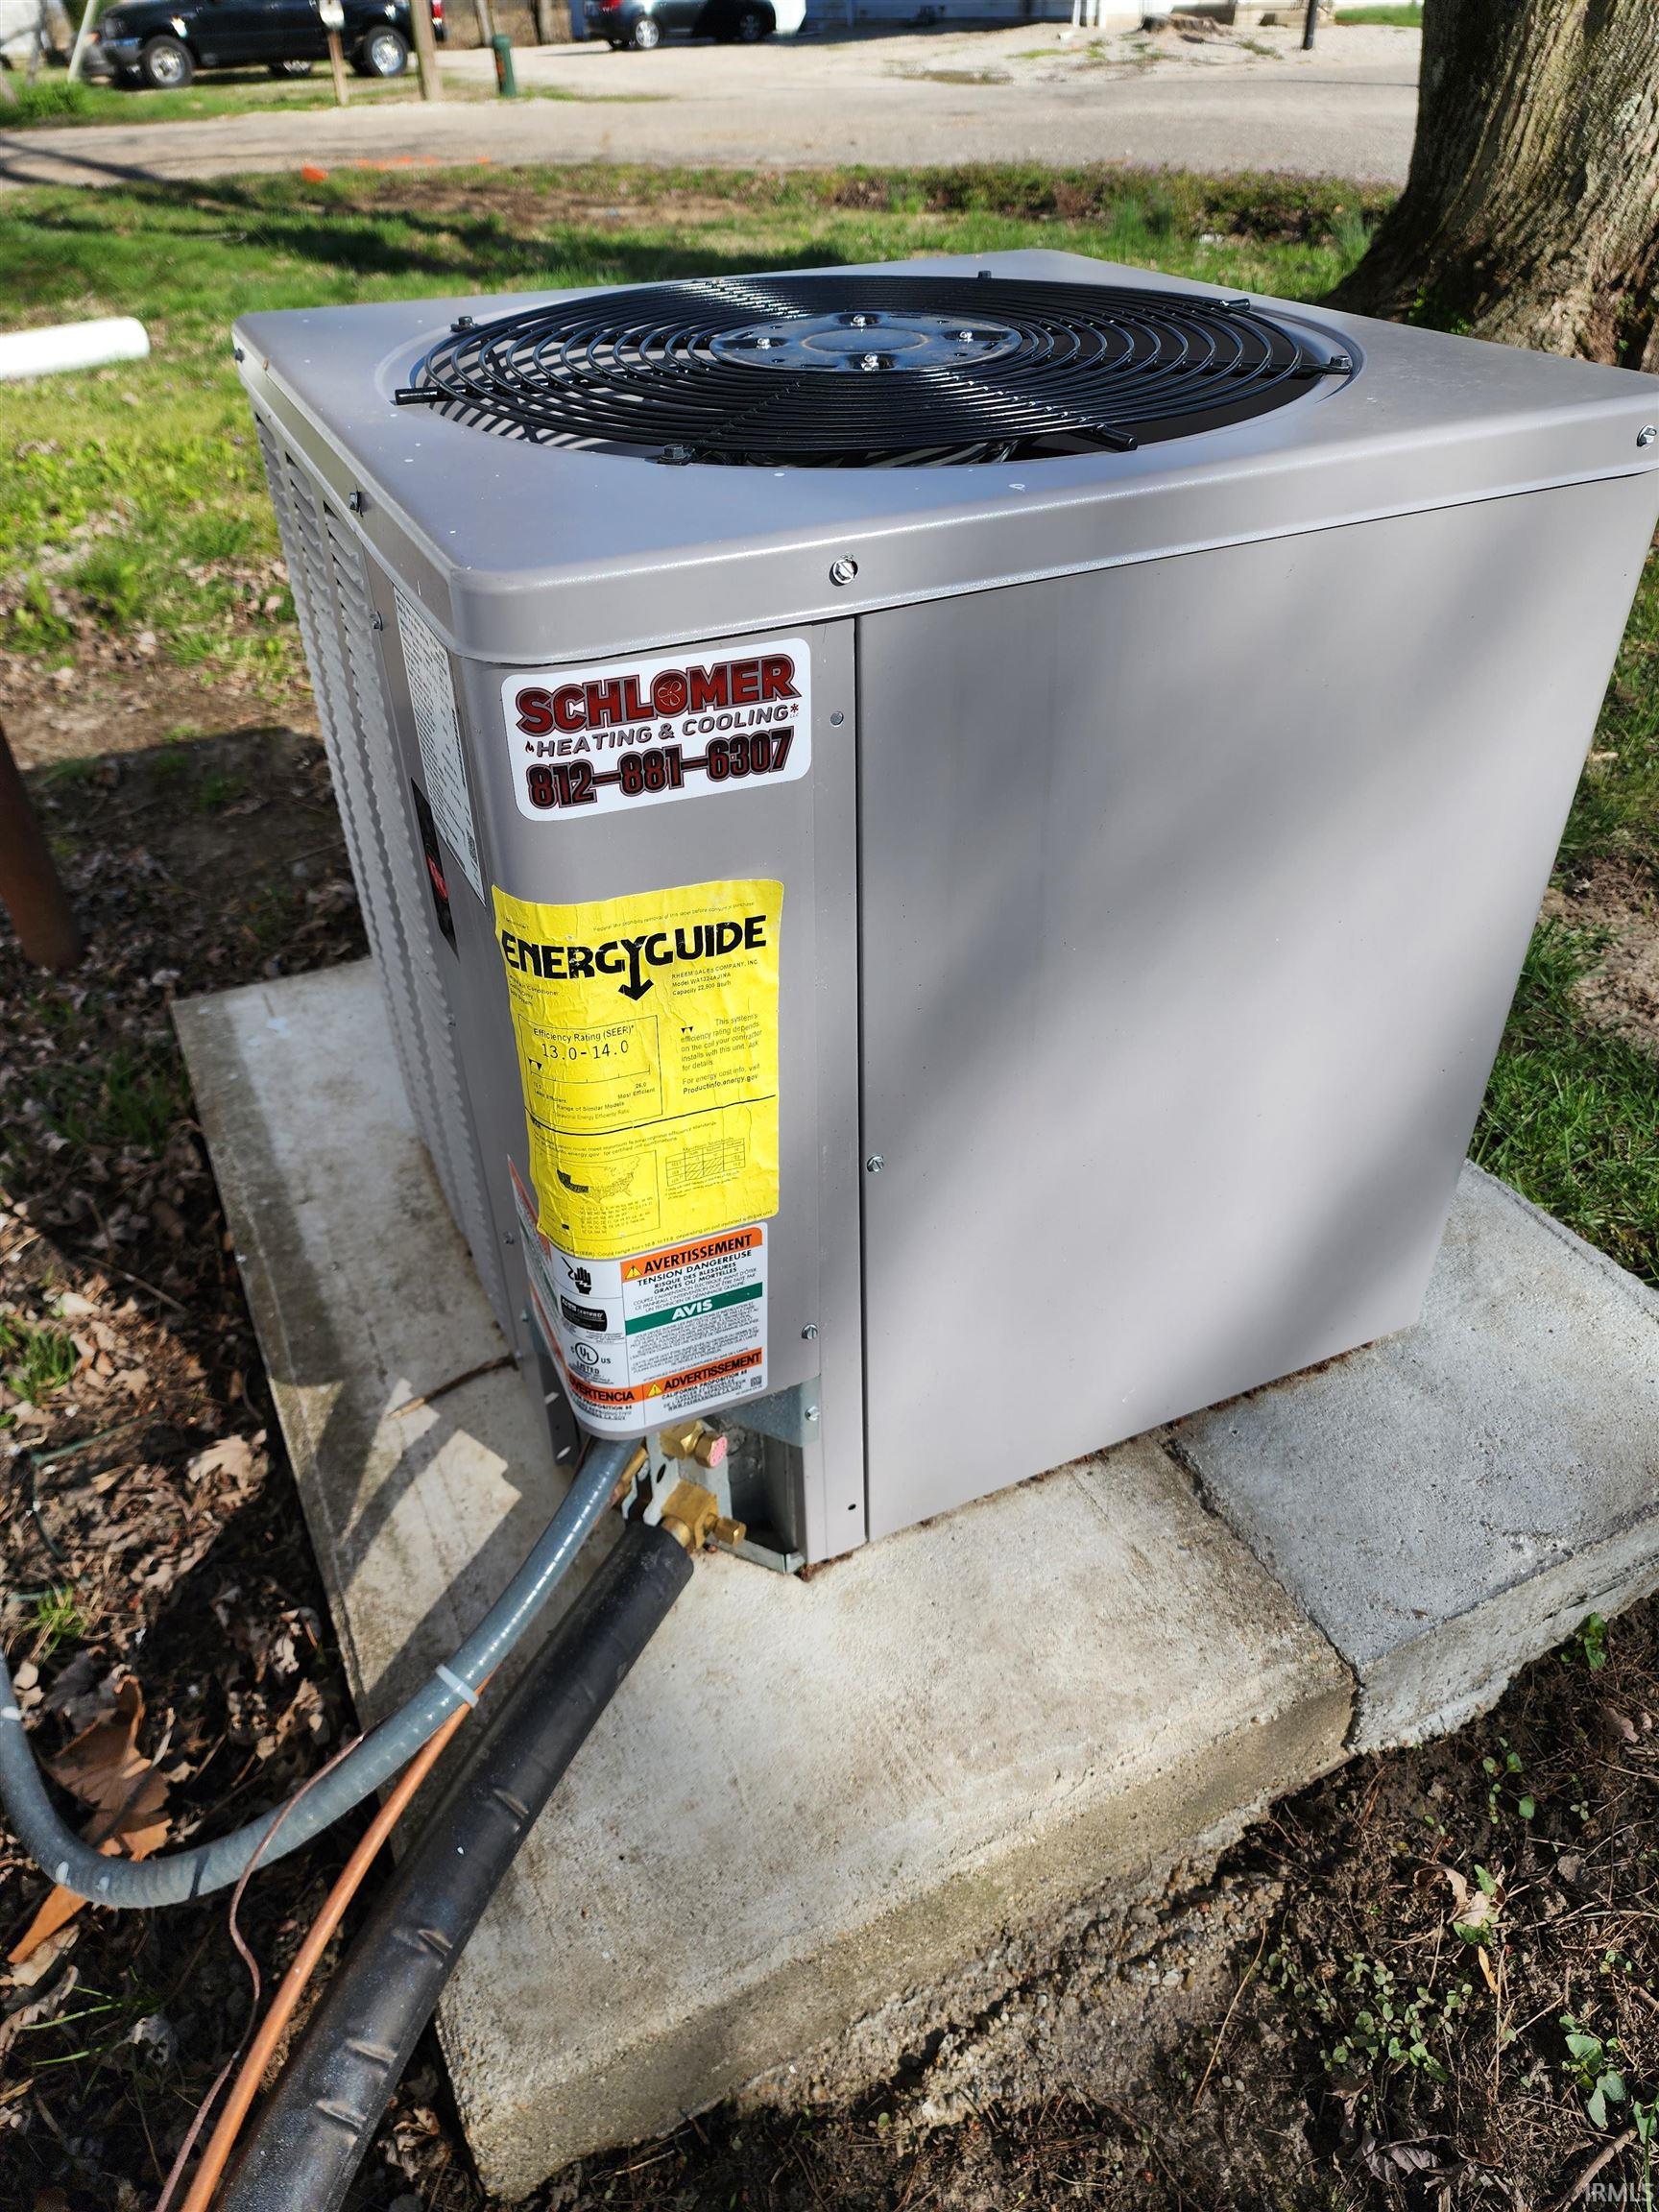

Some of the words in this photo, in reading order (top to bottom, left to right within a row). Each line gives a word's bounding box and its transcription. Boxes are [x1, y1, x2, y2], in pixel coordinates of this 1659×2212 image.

[516, 653, 803, 736] SCHLOMER
[537, 726, 653, 757] HEATING
[660, 723, 675, 740] &
[682, 705, 789, 734] COOLING
[526, 726, 795, 809] 812-881-6307
[501, 915, 767, 981] ENERGYGUIDE
[695, 968, 714, 976] SALES
[673, 988, 696, 997] Capacity
[681, 1031, 711, 1044] efficiency
[713, 1027, 732, 1037] rating
[733, 1021, 760, 1033] depends
[714, 1018, 730, 1026] This
[533, 1028, 571, 1043] Efficiency
[574, 1032, 601, 1043] Rating
[715, 1037, 730, 1047] your
[732, 1030, 763, 1042] contractor
[682, 1051, 705, 1062] installs
[706, 1048, 718, 1057] with
[748, 1040, 758, 1048] Ask
[696, 1072, 717, 1082] energy
[748, 1063, 760, 1071] visit
[644, 1235, 752, 1274] AVERTISSEMENT
[637, 1269, 683, 1286] TENSION
[686, 1250, 752, 1273] DANGEREUSE
[654, 1276, 681, 1288] RISQUE
[684, 1272, 697, 1281] DES
[699, 1262, 736, 1275] BLESSURES
[654, 1282, 683, 1295] GRAVES
[685, 1278, 696, 1286] OU
[698, 1267, 737, 1282] MORTELLES
[672, 1299, 712, 1320] AVIS
[577, 1360, 599, 1374] LISTED
[664, 1352, 761, 1390] ADVERTISSEMENT
[661, 1384, 698, 1400] CALIFORNIA
[699, 1373, 739, 1387] PROPOSITION
